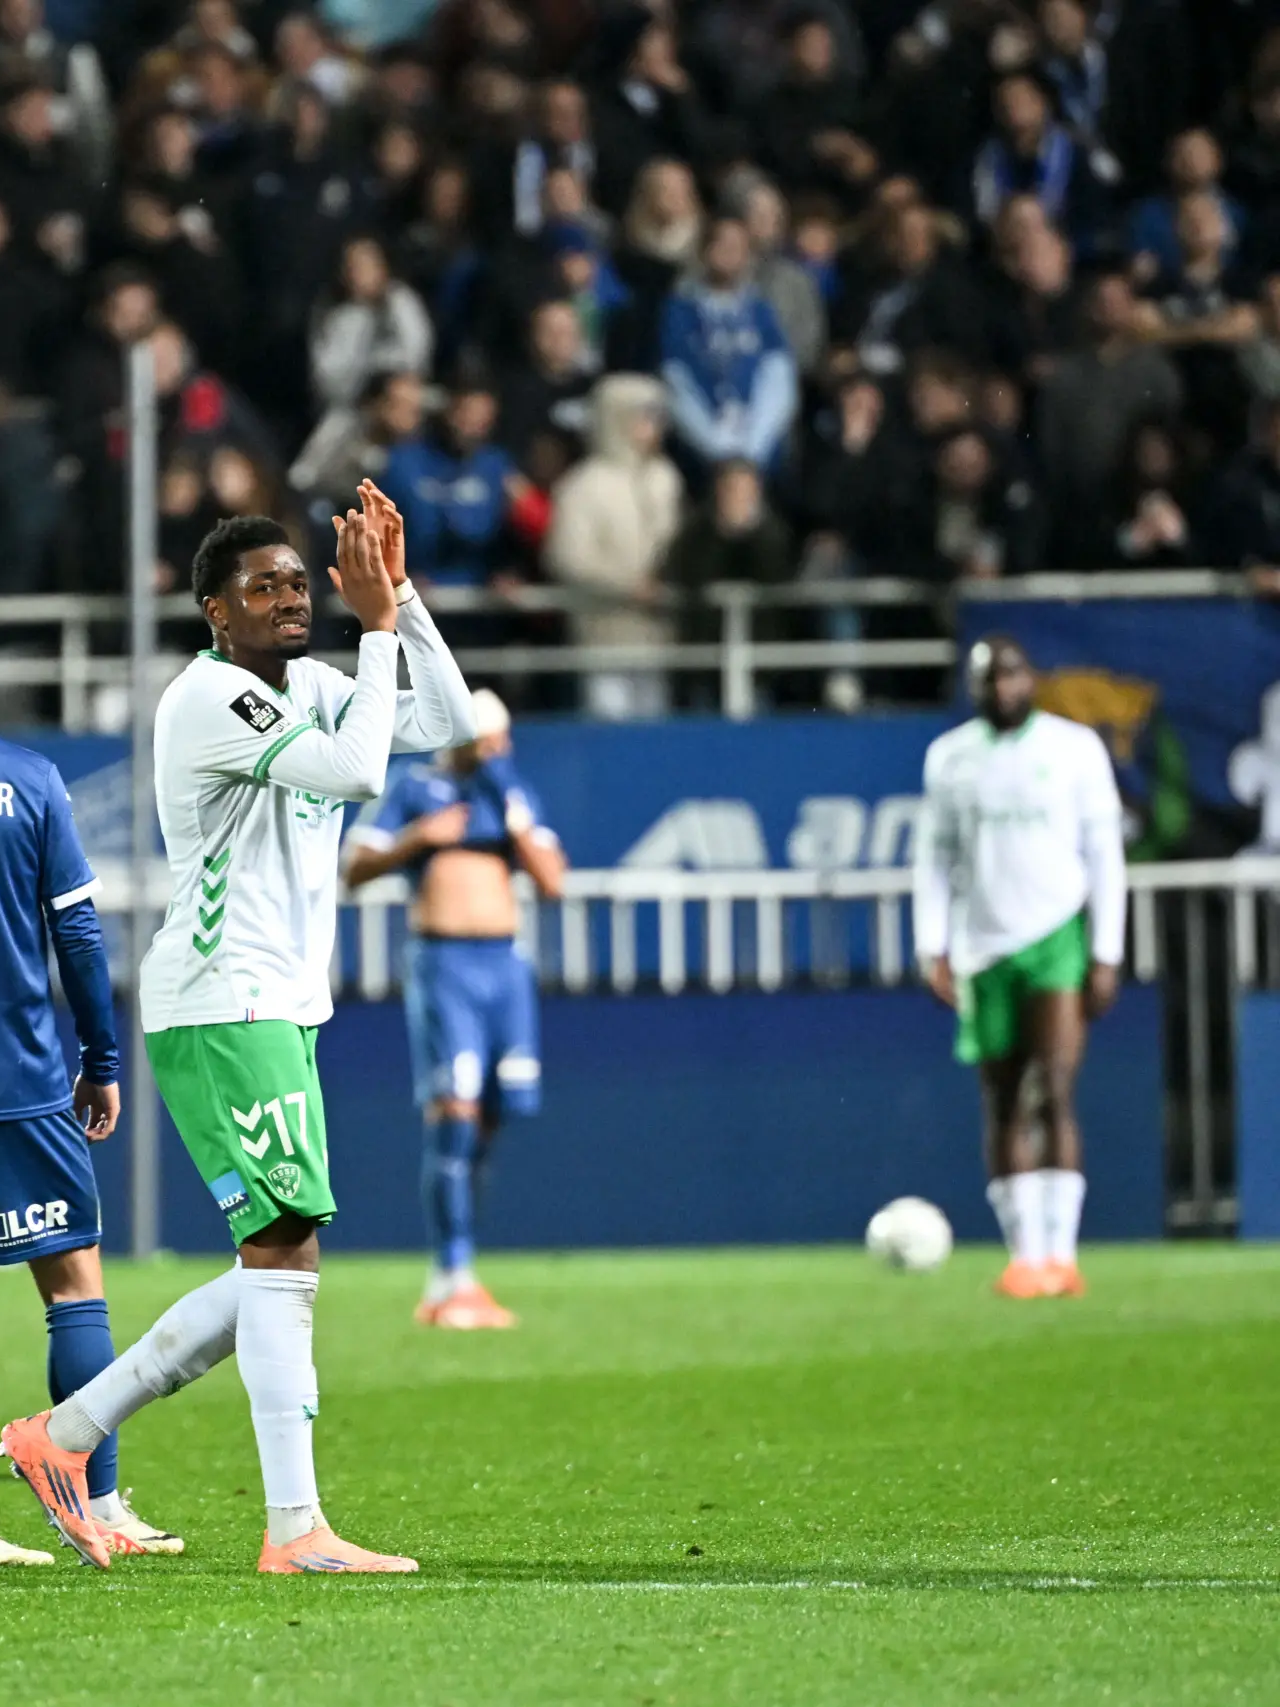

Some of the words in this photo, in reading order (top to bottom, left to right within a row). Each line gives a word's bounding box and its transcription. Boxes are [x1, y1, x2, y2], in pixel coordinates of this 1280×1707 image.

[263, 1091, 308, 1156] 17
[272, 1167, 297, 1180] ASSE
[8, 1200, 68, 1238] LCR
